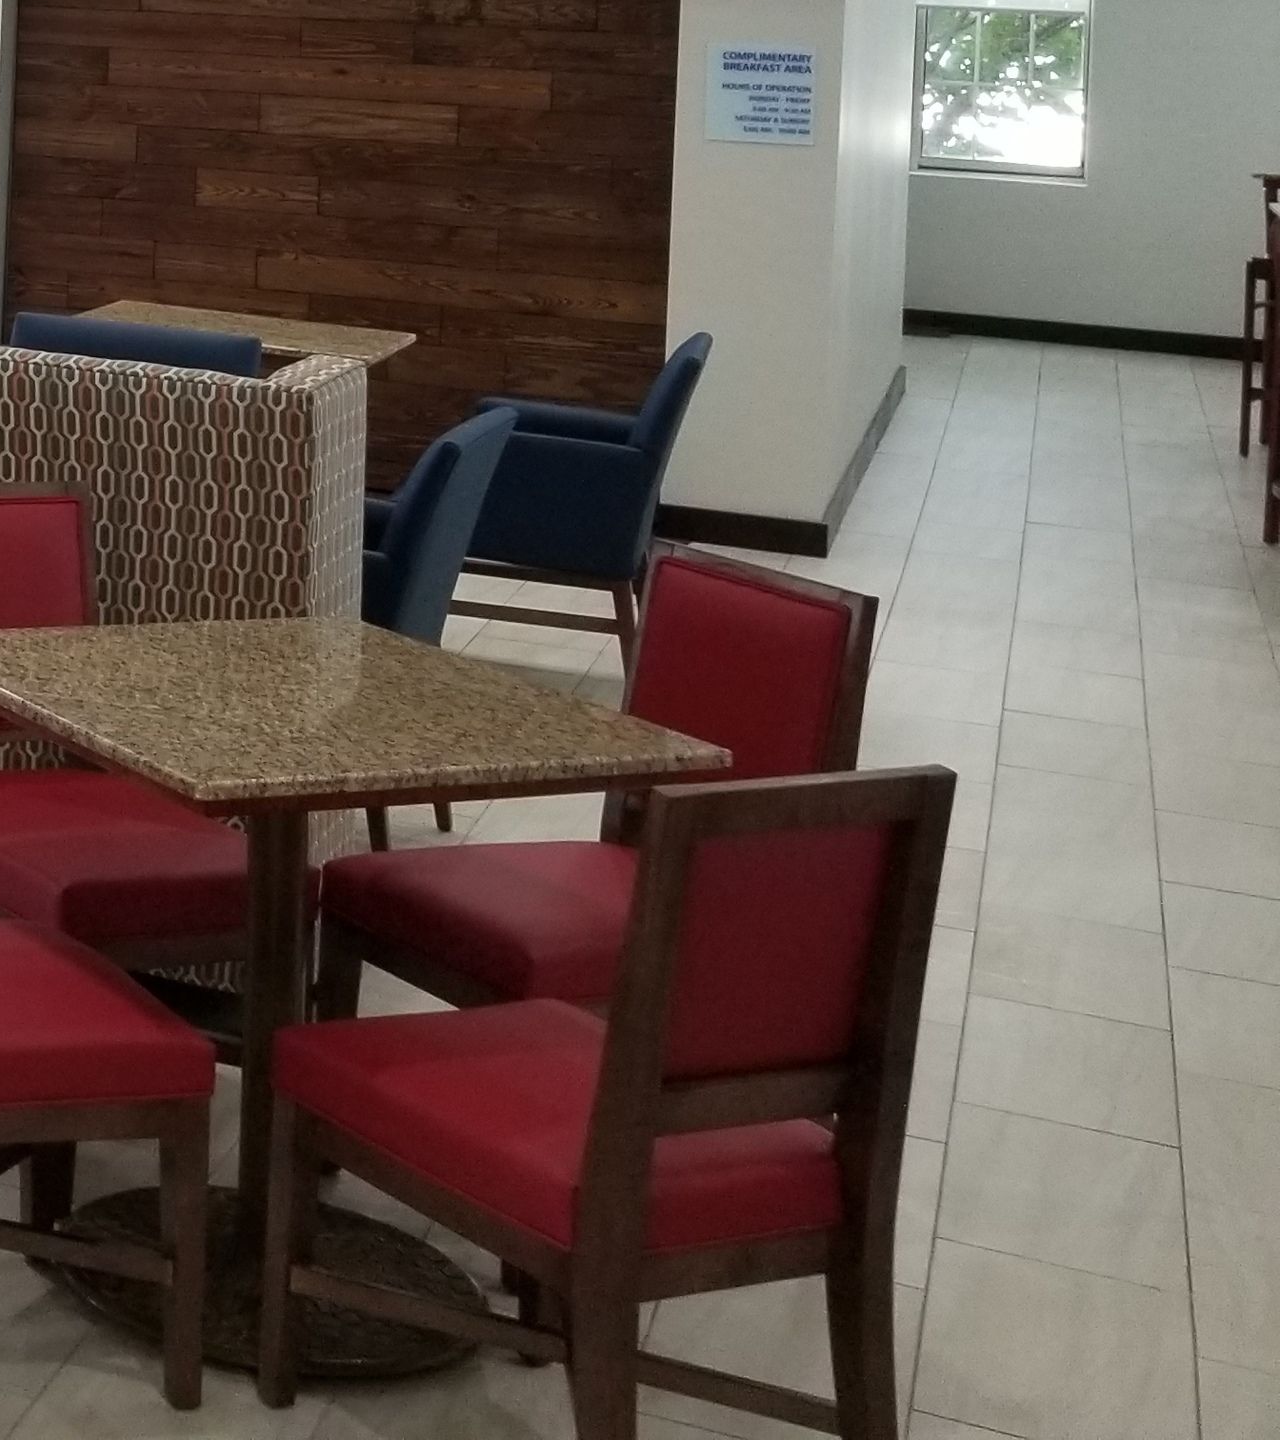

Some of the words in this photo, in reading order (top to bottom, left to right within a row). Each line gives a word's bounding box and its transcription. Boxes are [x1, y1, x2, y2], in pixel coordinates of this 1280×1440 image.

[722, 51, 813, 63] COMPLIMENTARY
[722, 62, 781, 72] BREAKFAST
[784, 65, 812, 74] AREA
[765, 84, 812, 93] OPERATION
